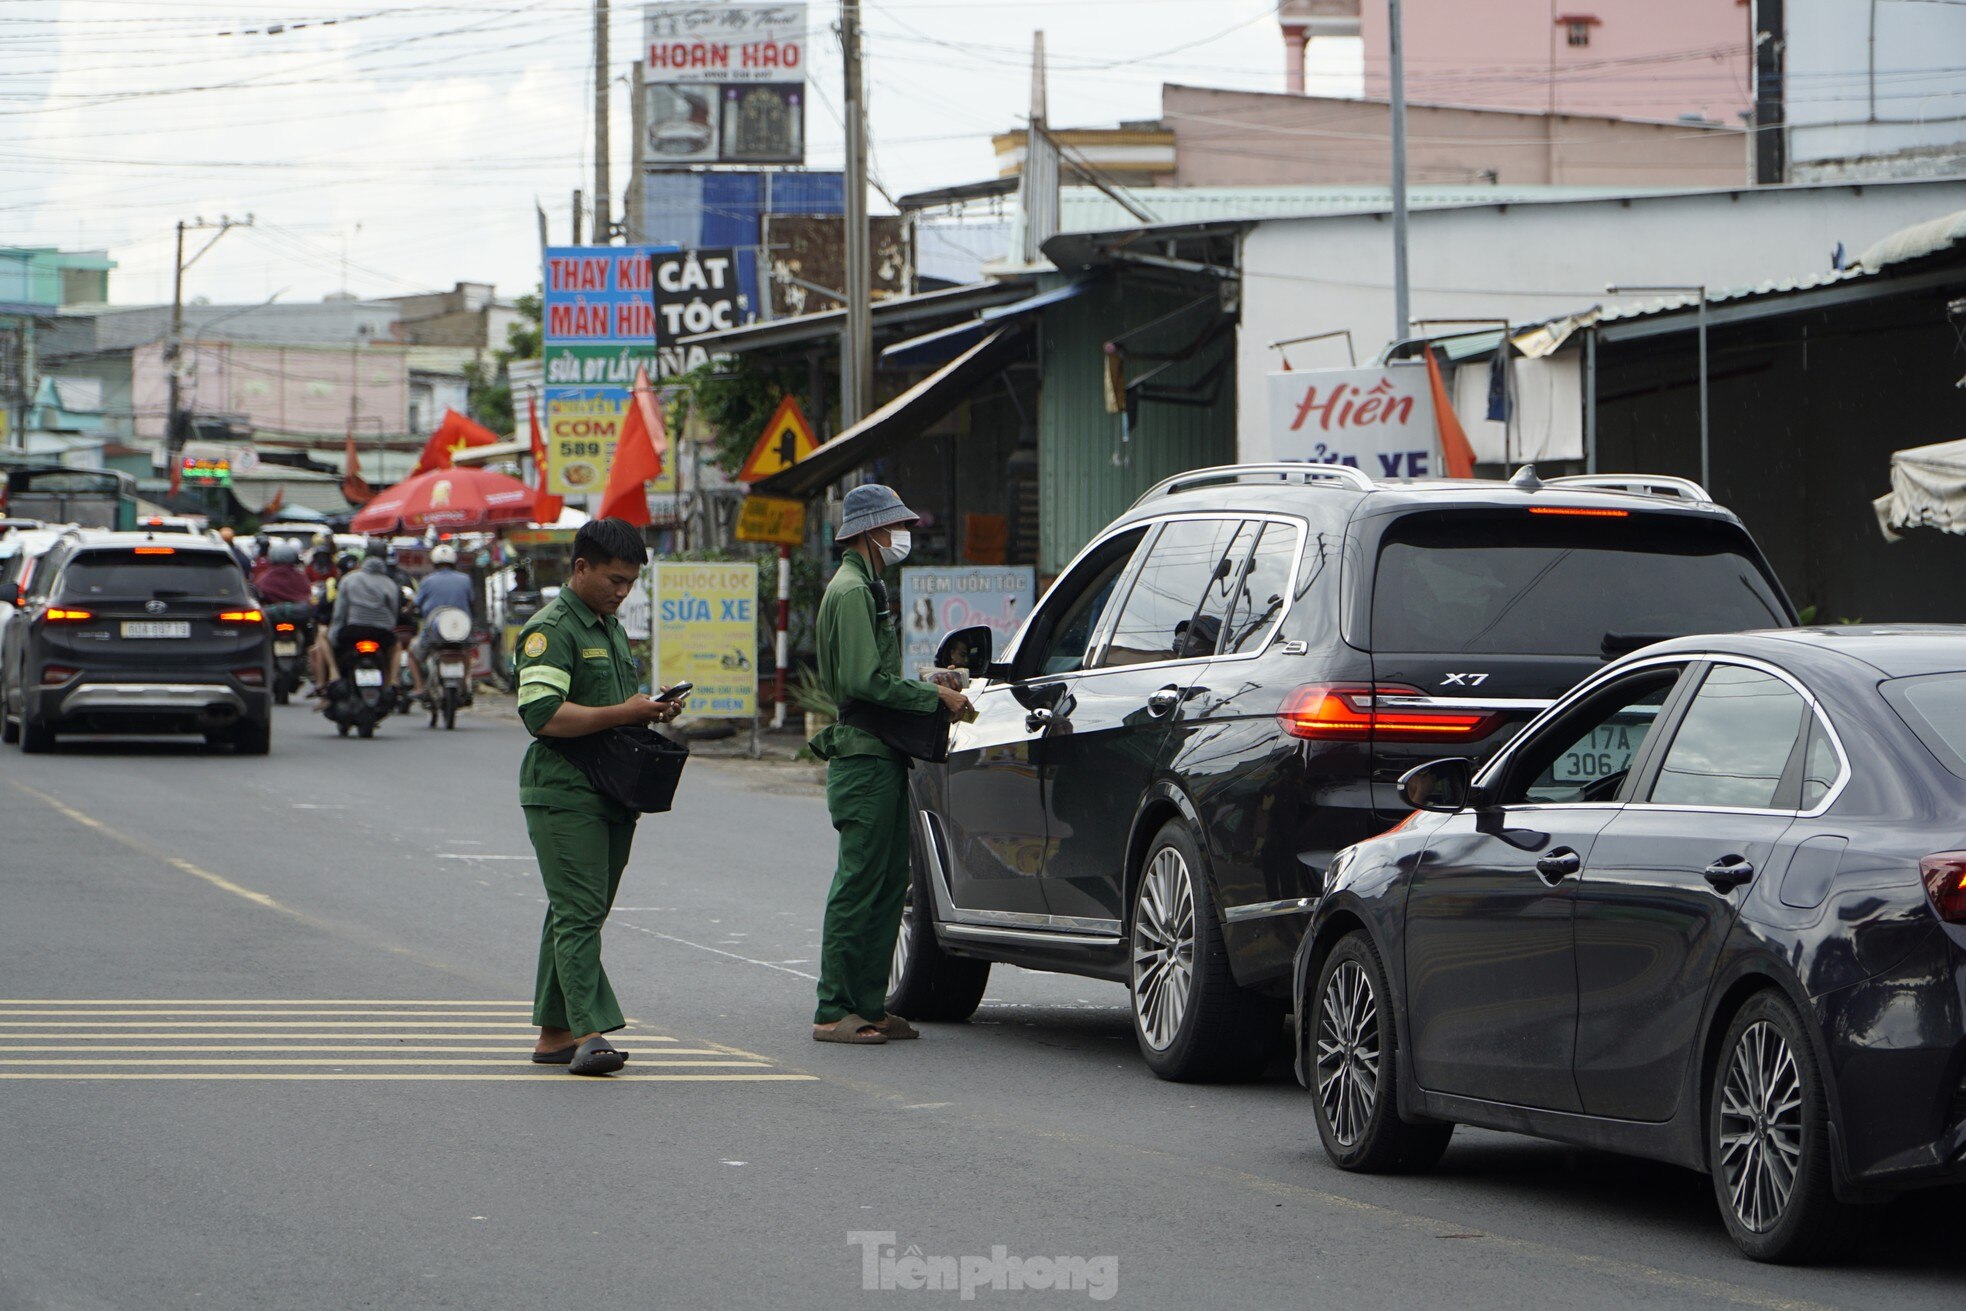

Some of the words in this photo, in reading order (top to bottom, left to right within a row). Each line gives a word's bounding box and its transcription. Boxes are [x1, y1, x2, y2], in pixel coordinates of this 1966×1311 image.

[651, 33, 729, 68] HOÀN
[550, 256, 611, 291] THAY
[658, 250, 730, 293] CẮT
[550, 294, 611, 336] MÀN
[660, 296, 733, 335] TÓC
[1290, 377, 1415, 432] Hiền
[554, 416, 616, 437] CƠM
[560, 441, 600, 458] 589
[1378, 450, 1429, 478] XE
[912, 573, 952, 594] TIỆM
[957, 570, 992, 593] UỐN
[996, 572, 1027, 593] TÓC
[661, 591, 712, 622] SỬA
[721, 599, 752, 622] XE
[1440, 673, 1490, 686] X7
